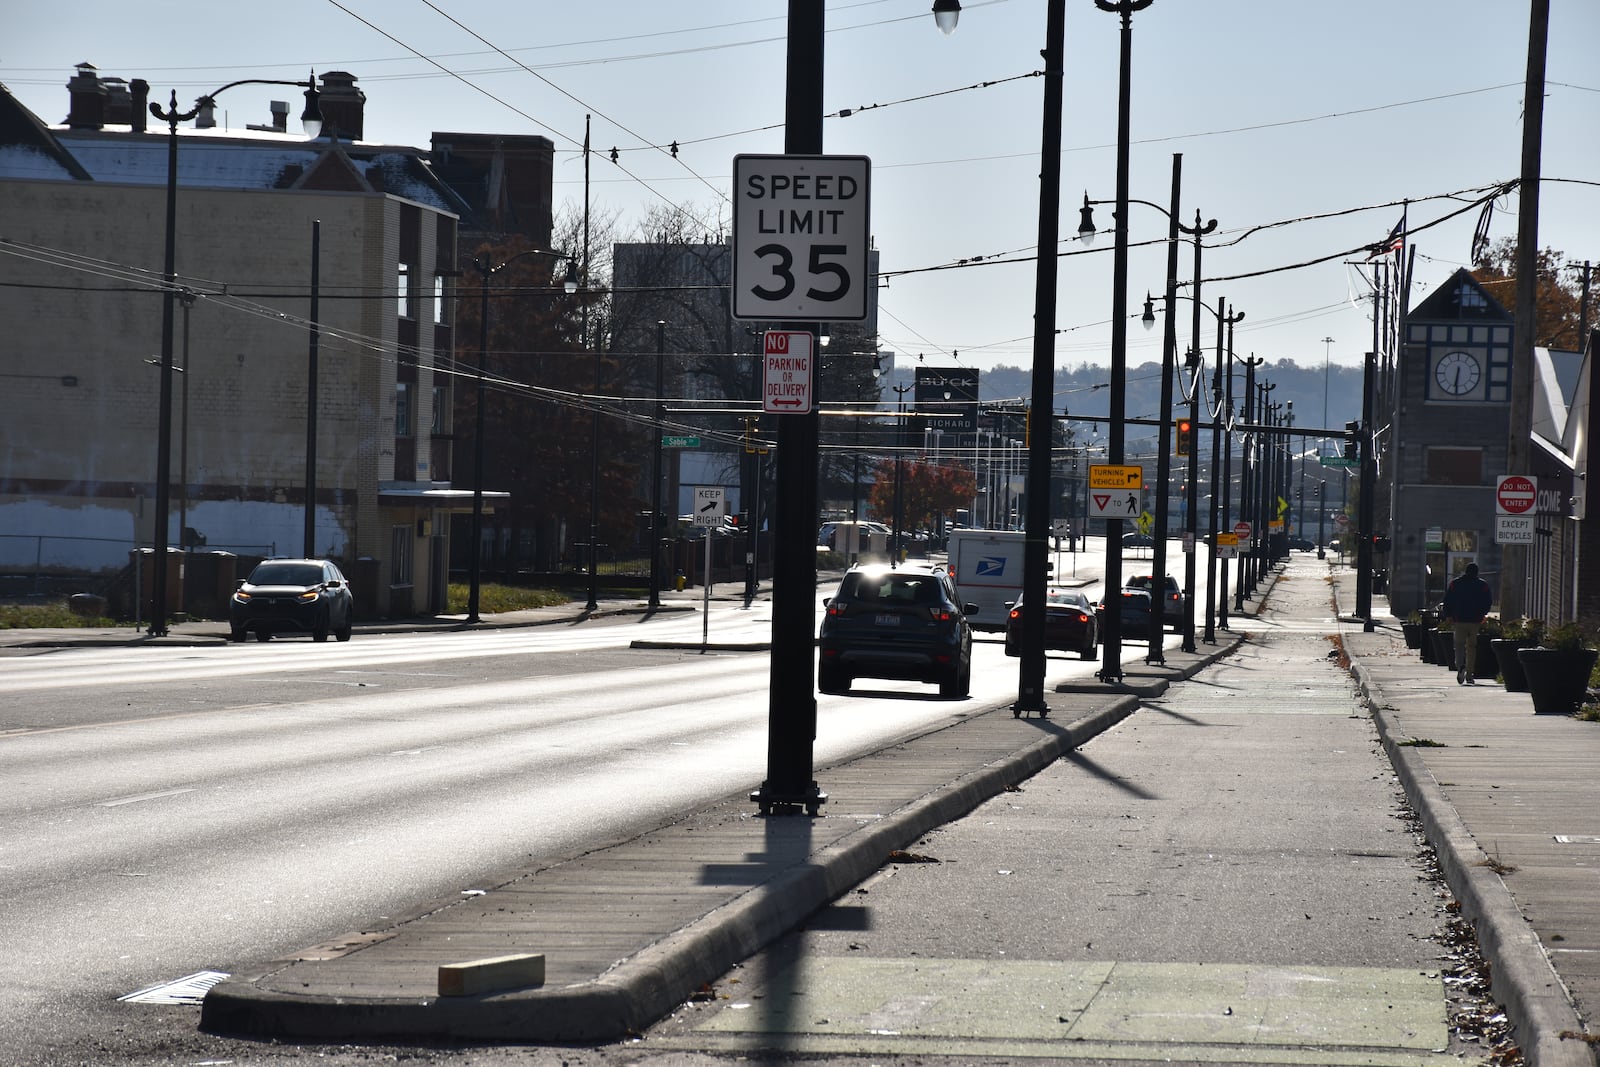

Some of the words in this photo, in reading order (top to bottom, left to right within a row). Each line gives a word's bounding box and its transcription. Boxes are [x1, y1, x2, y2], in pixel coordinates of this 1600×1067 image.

[746, 174, 858, 200] SPEED
[759, 209, 844, 235] LIMIT
[750, 243, 851, 302] 35
[767, 334, 786, 350] NO
[769, 358, 807, 371] PARKING
[782, 372, 793, 383] OR
[768, 383, 807, 397] DELIVERY
[1322, 458, 1350, 466] Superior
[1092, 478, 1125, 486] VEHICLES
[1517, 483, 1531, 491] NOT
[699, 490, 721, 499] KEEP
[1505, 499, 1528, 507] ENTER
[1536, 489, 1561, 512] COME
[696, 515, 722, 525] RIGHT
[1501, 520, 1529, 529] EXCEPT
[1498, 531, 1532, 541] BICYCLES
